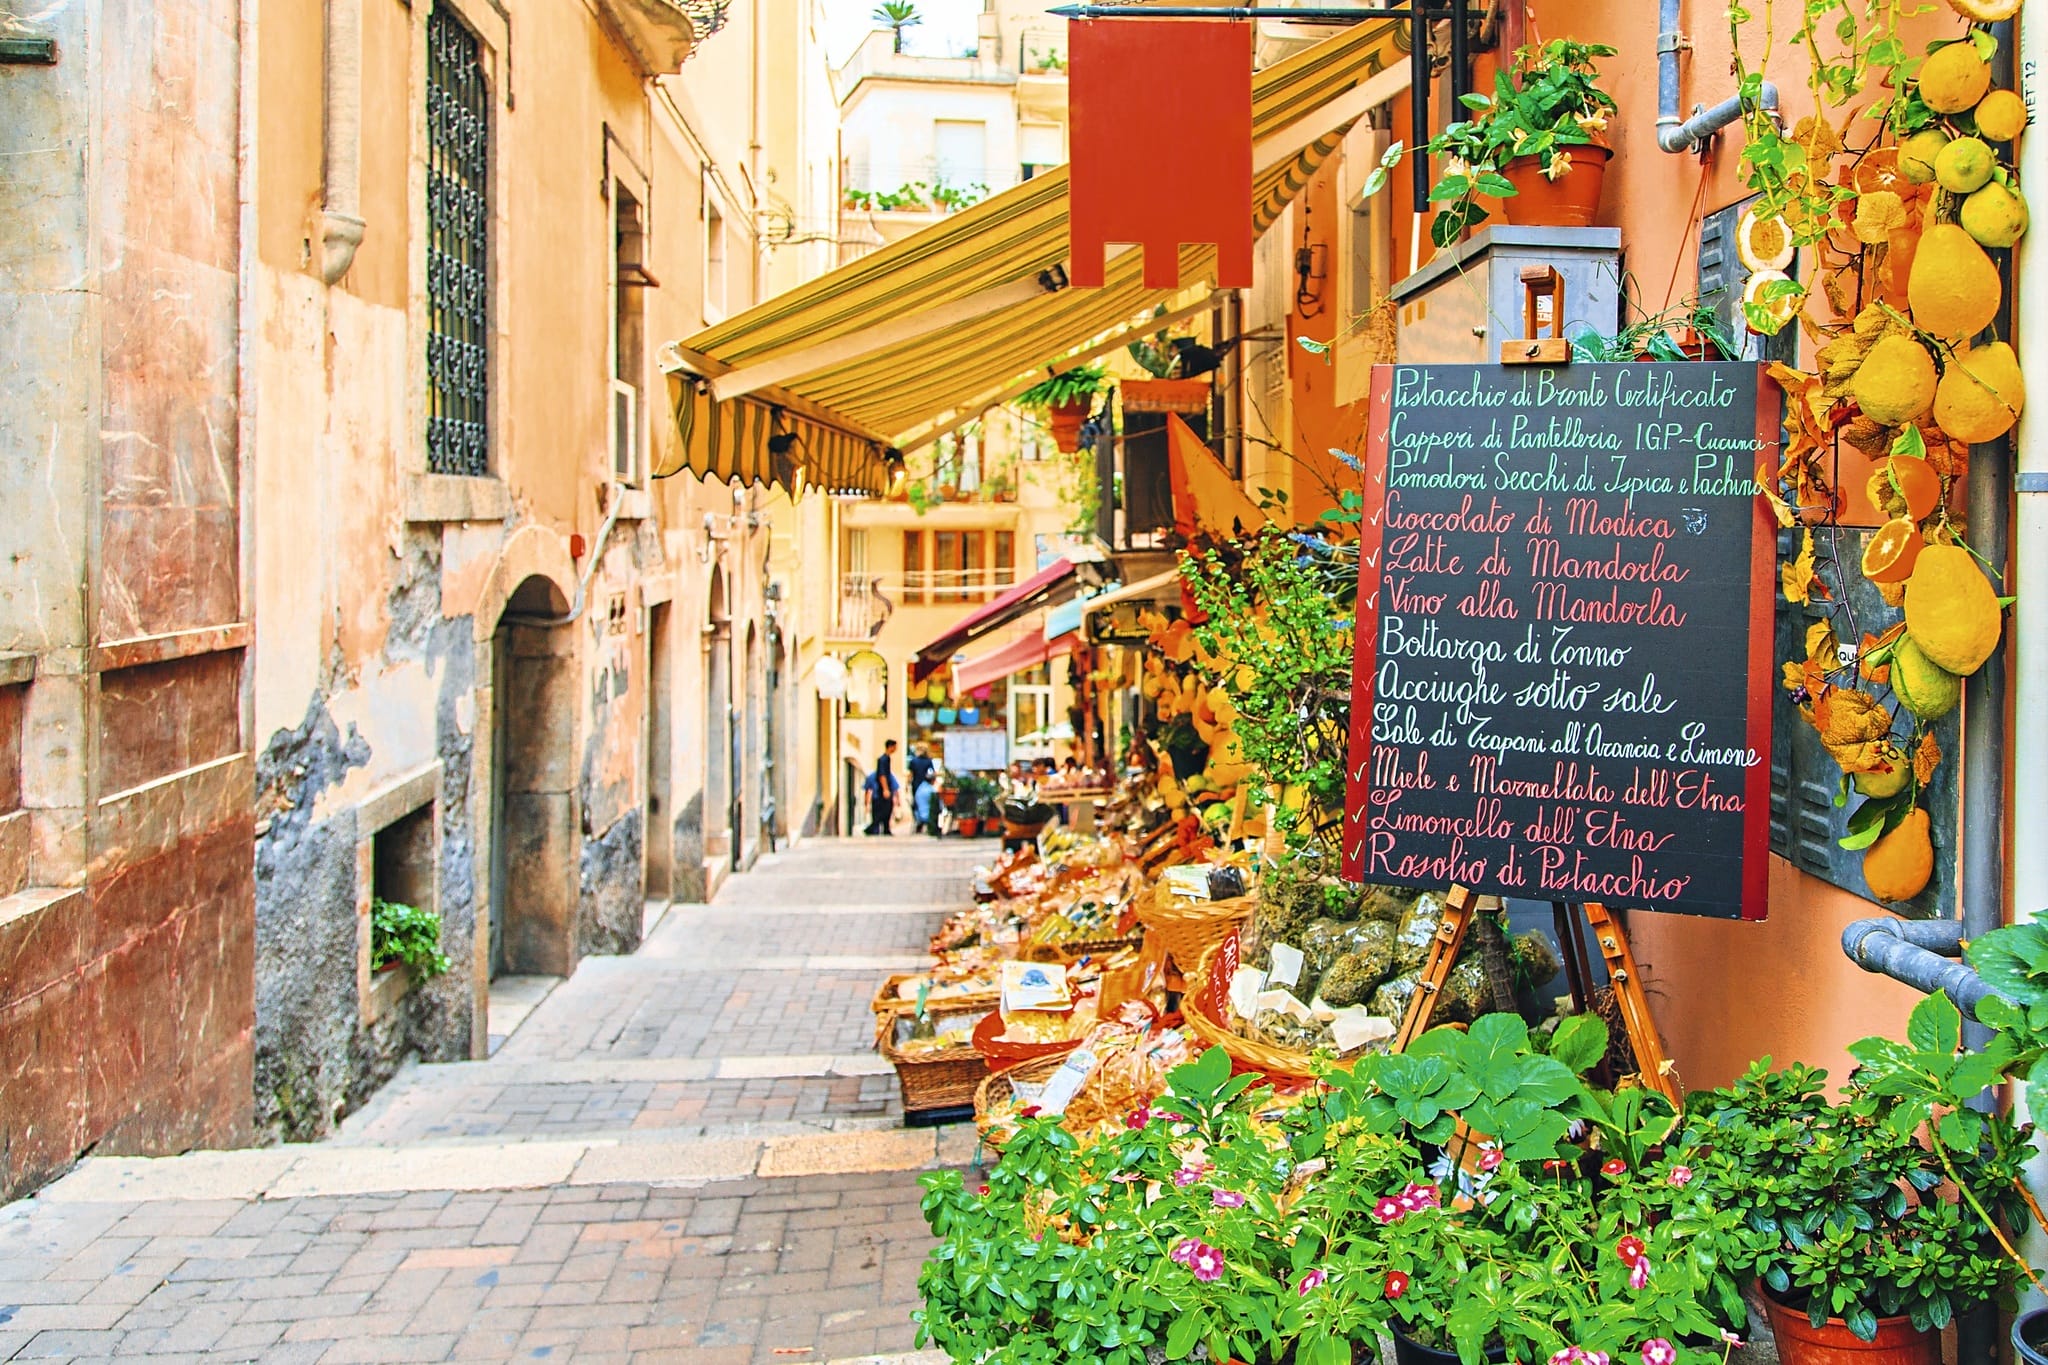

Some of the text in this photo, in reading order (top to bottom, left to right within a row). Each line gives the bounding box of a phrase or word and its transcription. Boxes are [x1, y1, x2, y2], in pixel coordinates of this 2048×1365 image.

[1395, 368, 1737, 418] Pistacchio di Bronte Certificato
[1391, 412, 1475, 464] Capperi
[1480, 418, 1503, 448] di
[1511, 415, 1622, 449] Pantelleria
[1390, 449, 1487, 489] Pomodori
[1494, 452, 1569, 491] Secchi
[1573, 455, 1597, 492] di
[1678, 478, 1688, 495] e
[1693, 453, 1763, 496] Pachino
[1385, 490, 1676, 539] Cioccolato di Modica
[1386, 532, 1690, 583] Latte di Mandorla
[1384, 574, 1687, 627] Vino alla Mandorla
[1383, 616, 1632, 676] Bottarga di Tonno
[1838, 651, 1857, 662] QU
[1379, 660, 1678, 725] Acciughe sotto sale
[1372, 702, 1424, 742] Sale
[1429, 711, 1457, 746] di
[1467, 711, 1546, 766] Trapani
[1666, 743, 1678, 762] e
[1681, 721, 1762, 767] Limone
[1372, 744, 1436, 790] Miele
[1445, 774, 1460, 792] e
[1469, 753, 1615, 803] Marmellata
[1370, 789, 1515, 839] Limoncello
[1368, 832, 1692, 900] Rosolio di Pistacchio
